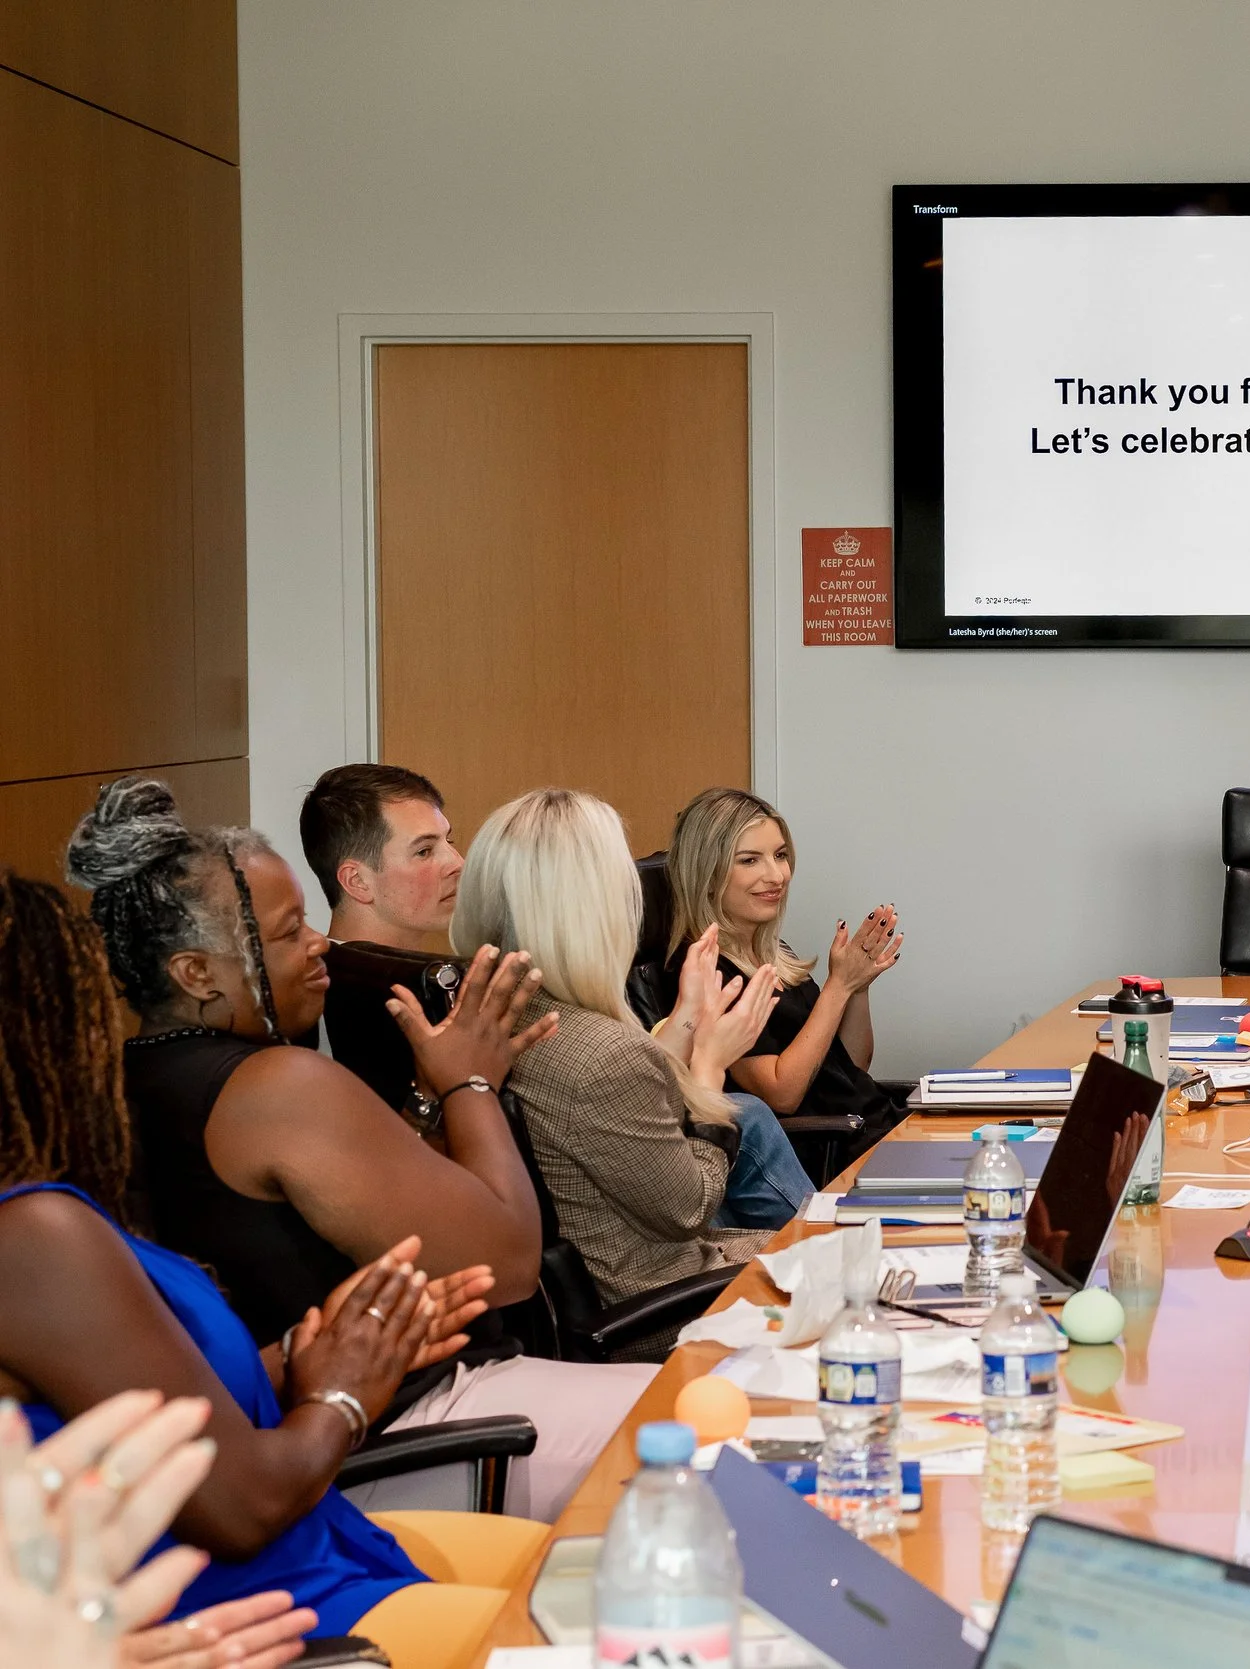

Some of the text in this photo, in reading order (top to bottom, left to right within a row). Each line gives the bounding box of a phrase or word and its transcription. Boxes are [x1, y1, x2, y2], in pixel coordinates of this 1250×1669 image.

[912, 204, 958, 214] Transform
[1054, 378, 1158, 405] Thank
[1168, 385, 1228, 411] you
[1032, 427, 1109, 454] Let’s
[820, 558, 875, 568] KEEP CALM
[820, 580, 877, 590] CARRY OUT
[808, 593, 888, 603] ALL PAPERWORK
[842, 606, 872, 615] TRASH
[805, 619, 892, 629] WHEN YOU LEAVE
[821, 632, 877, 642] THIS ROOM
[949, 628, 977, 636] Latesha
[978, 628, 995, 637] Byrd
[996, 628, 1033, 637] (she/her)'s
